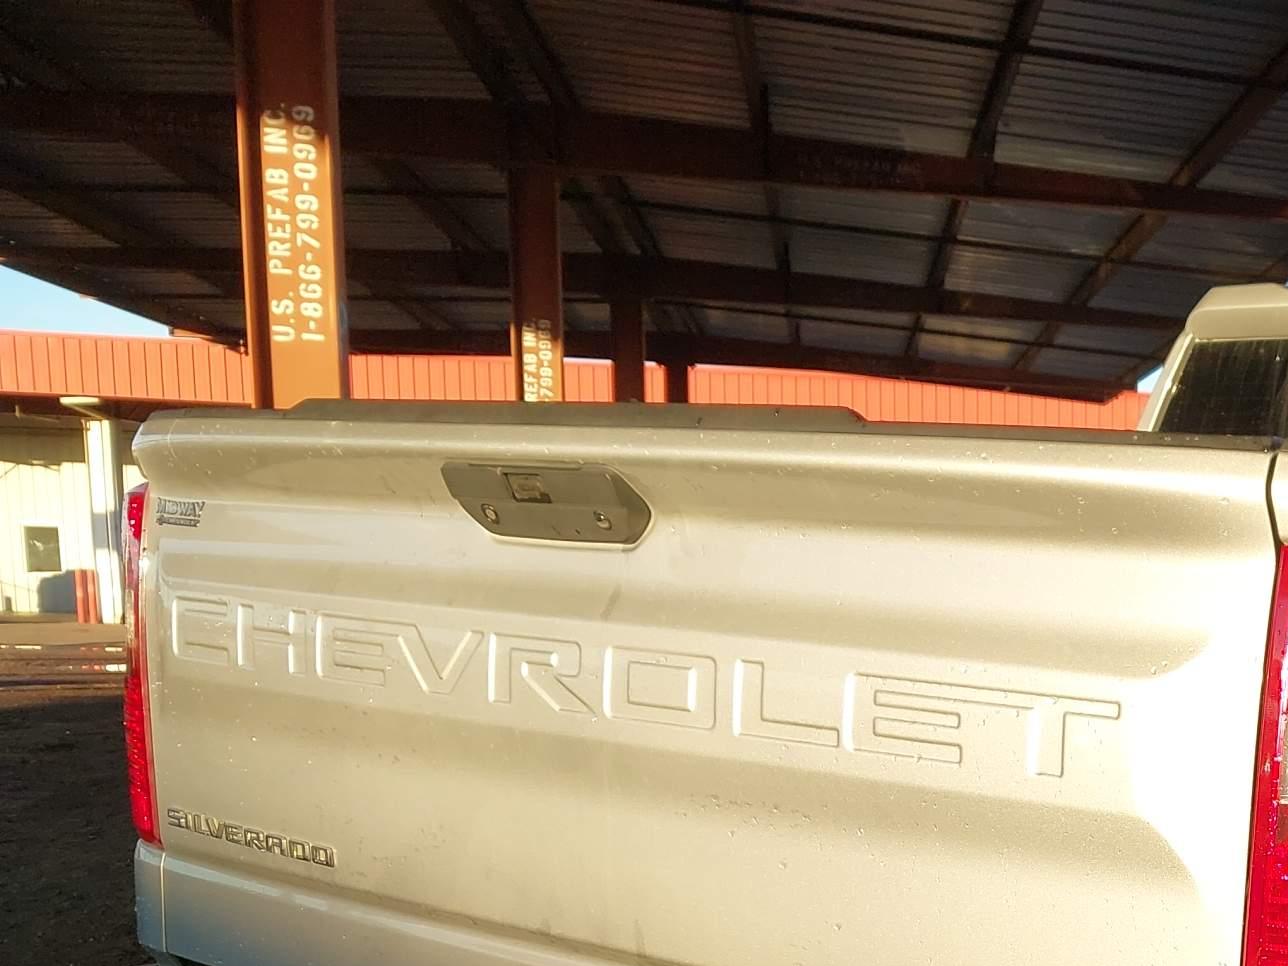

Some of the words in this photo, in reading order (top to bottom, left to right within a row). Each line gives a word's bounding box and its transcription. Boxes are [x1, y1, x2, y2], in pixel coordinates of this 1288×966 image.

[262, 103, 289, 154] INC.
[265, 167, 293, 276] PREFAB
[291, 105, 326, 342] 1-866-799-0969
[271, 291, 296, 342] U.S.
[171, 596, 1121, 778] CHEVROLET
[167, 807, 336, 868] SILVERADO
